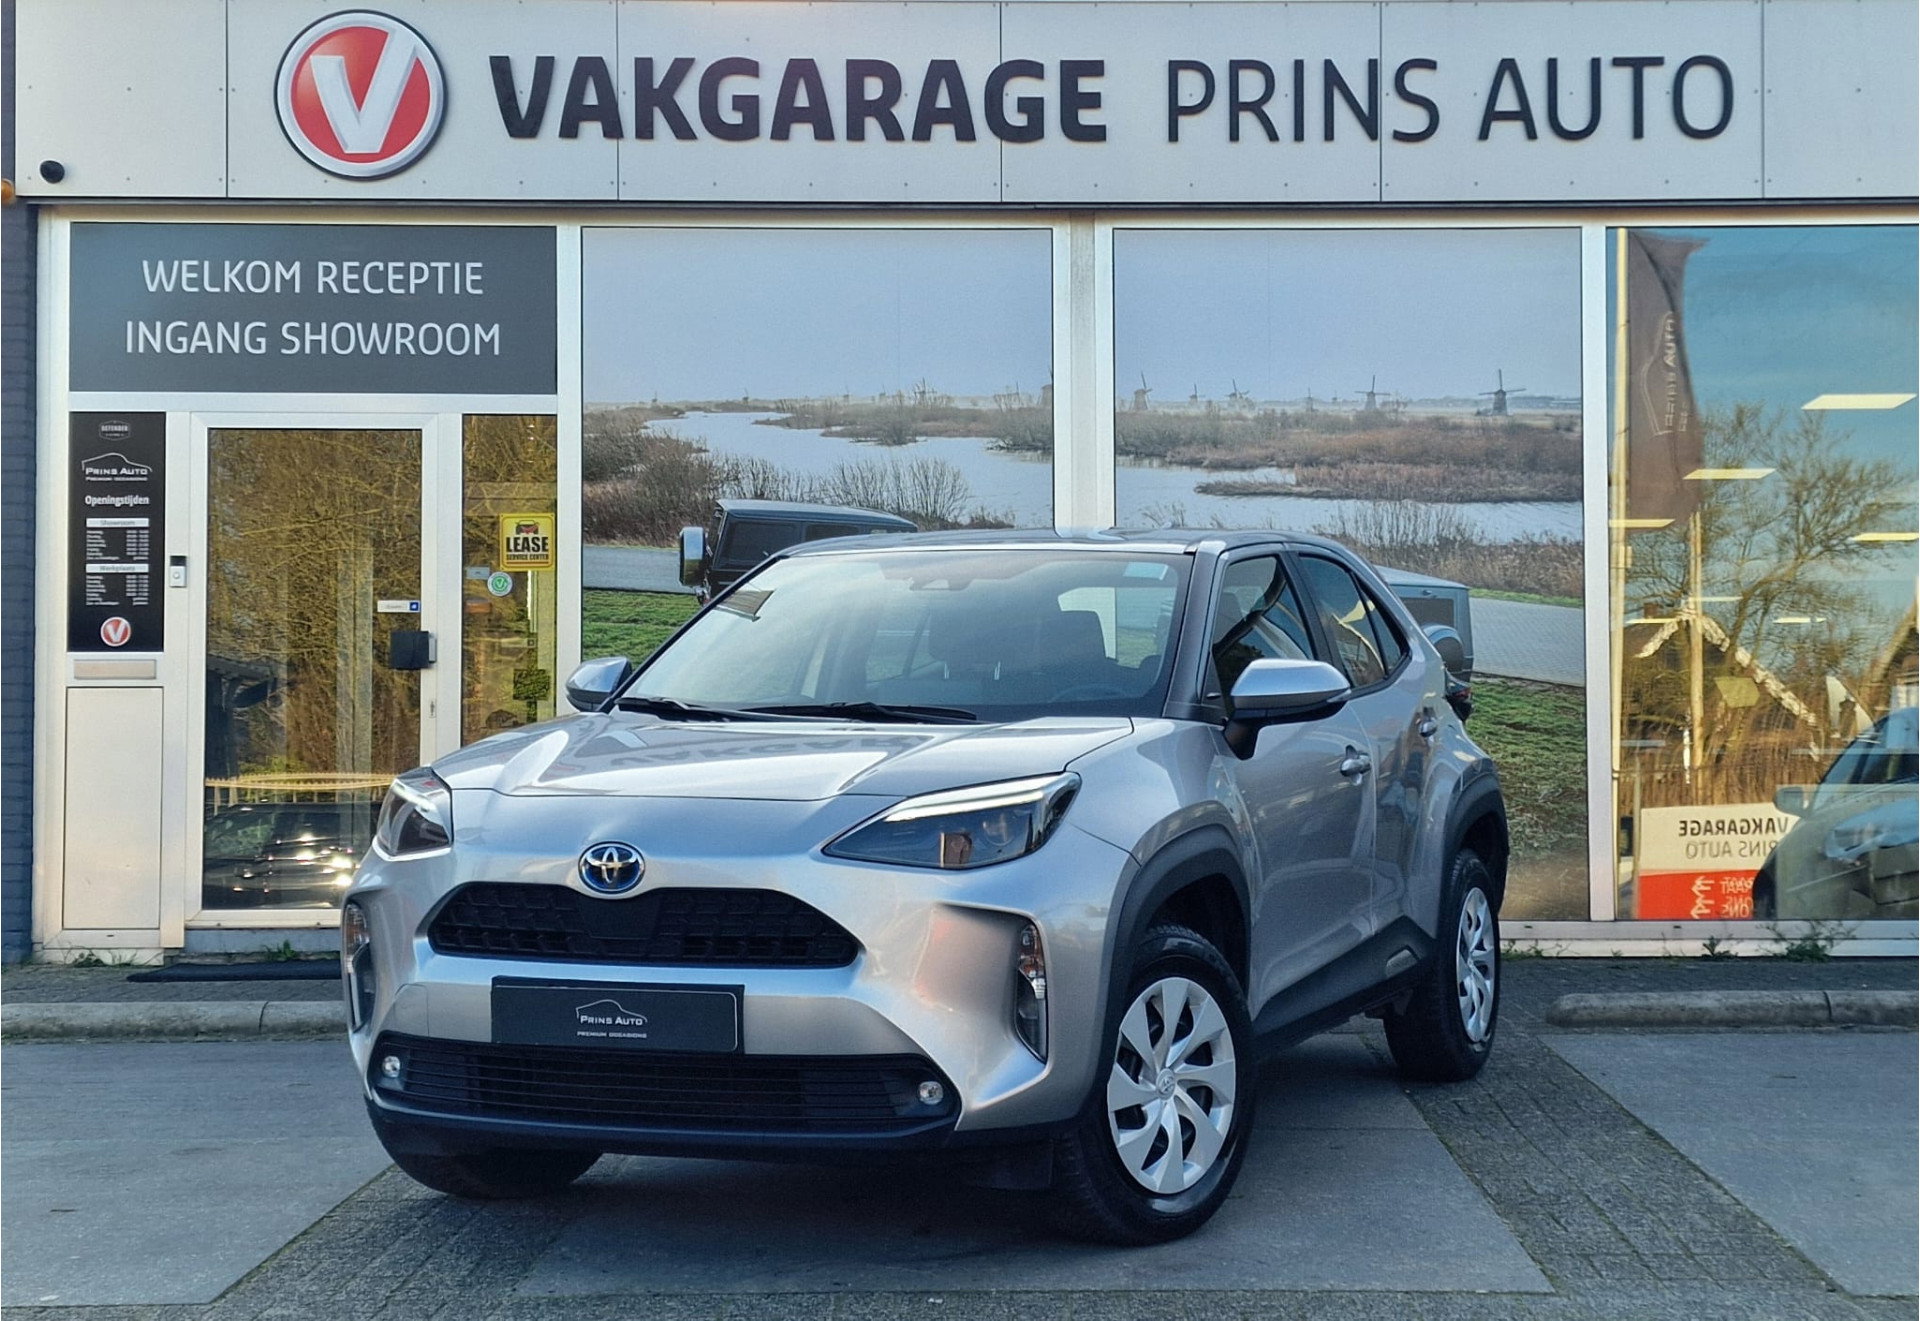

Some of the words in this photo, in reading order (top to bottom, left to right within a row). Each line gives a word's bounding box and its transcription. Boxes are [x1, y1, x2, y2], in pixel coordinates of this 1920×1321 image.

[489, 55, 1107, 143] VAKGARAGE
[1168, 57, 1441, 143] PRINS
[1477, 54, 1735, 142] AUTO
[142, 260, 301, 294] WELKOM
[317, 261, 484, 295] RECEPTIE
[125, 320, 267, 355] INGANG
[280, 321, 501, 357] SHOWROOM
[120, 467, 148, 475] AUTO
[85, 494, 150, 507] Openingstijden
[506, 536, 549, 553] LEASE
[580, 1015, 613, 1025] PRINS
[615, 1016, 643, 1026] AUTO
